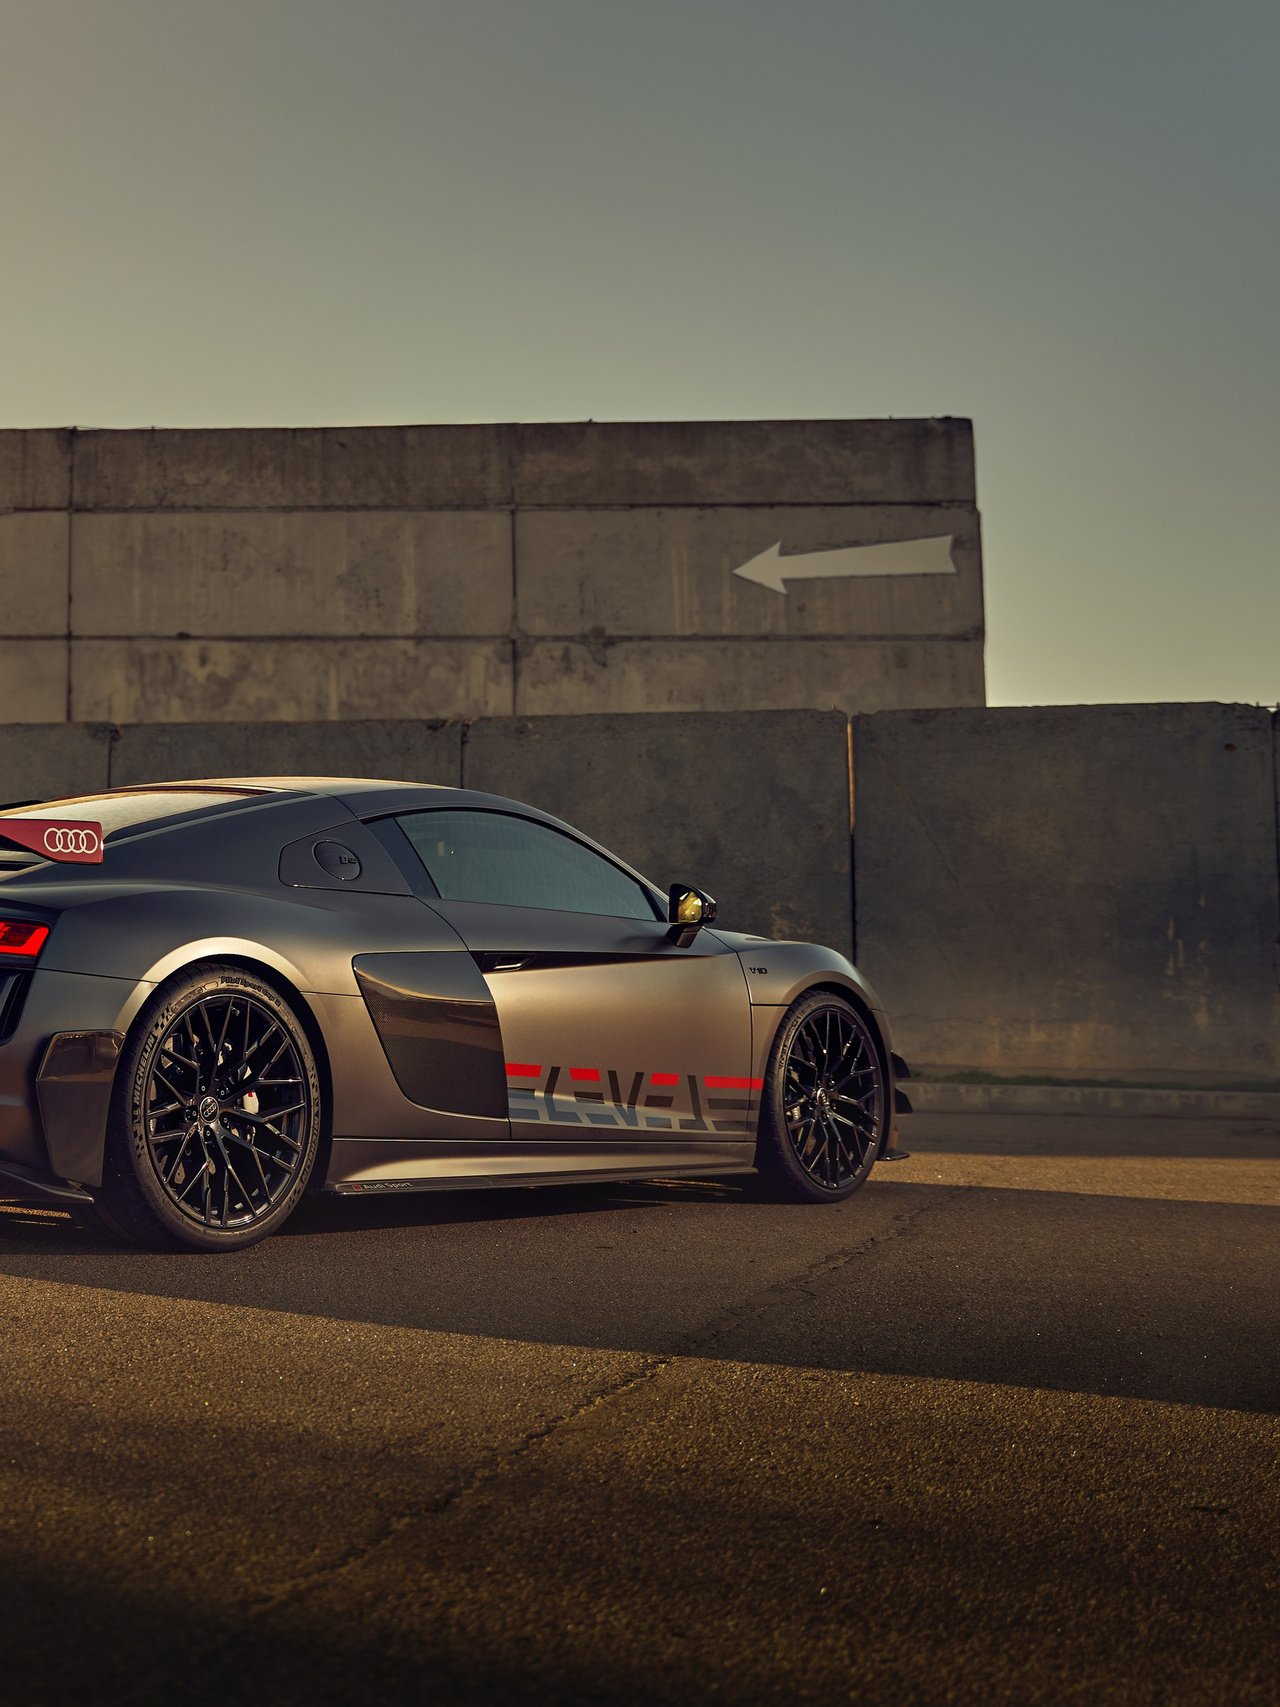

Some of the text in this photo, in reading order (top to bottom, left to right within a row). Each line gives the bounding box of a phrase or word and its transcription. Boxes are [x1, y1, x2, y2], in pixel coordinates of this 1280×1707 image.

[749, 966, 768, 975] V10
[220, 976, 240, 985] Pilot
[240, 979, 262, 991] Sport
[261, 988, 277, 1002] Cup
[133, 1033, 157, 1105] MICHELIN
[302, 1116, 320, 1184] MICHELIN
[384, 1181, 414, 1189] Sport
